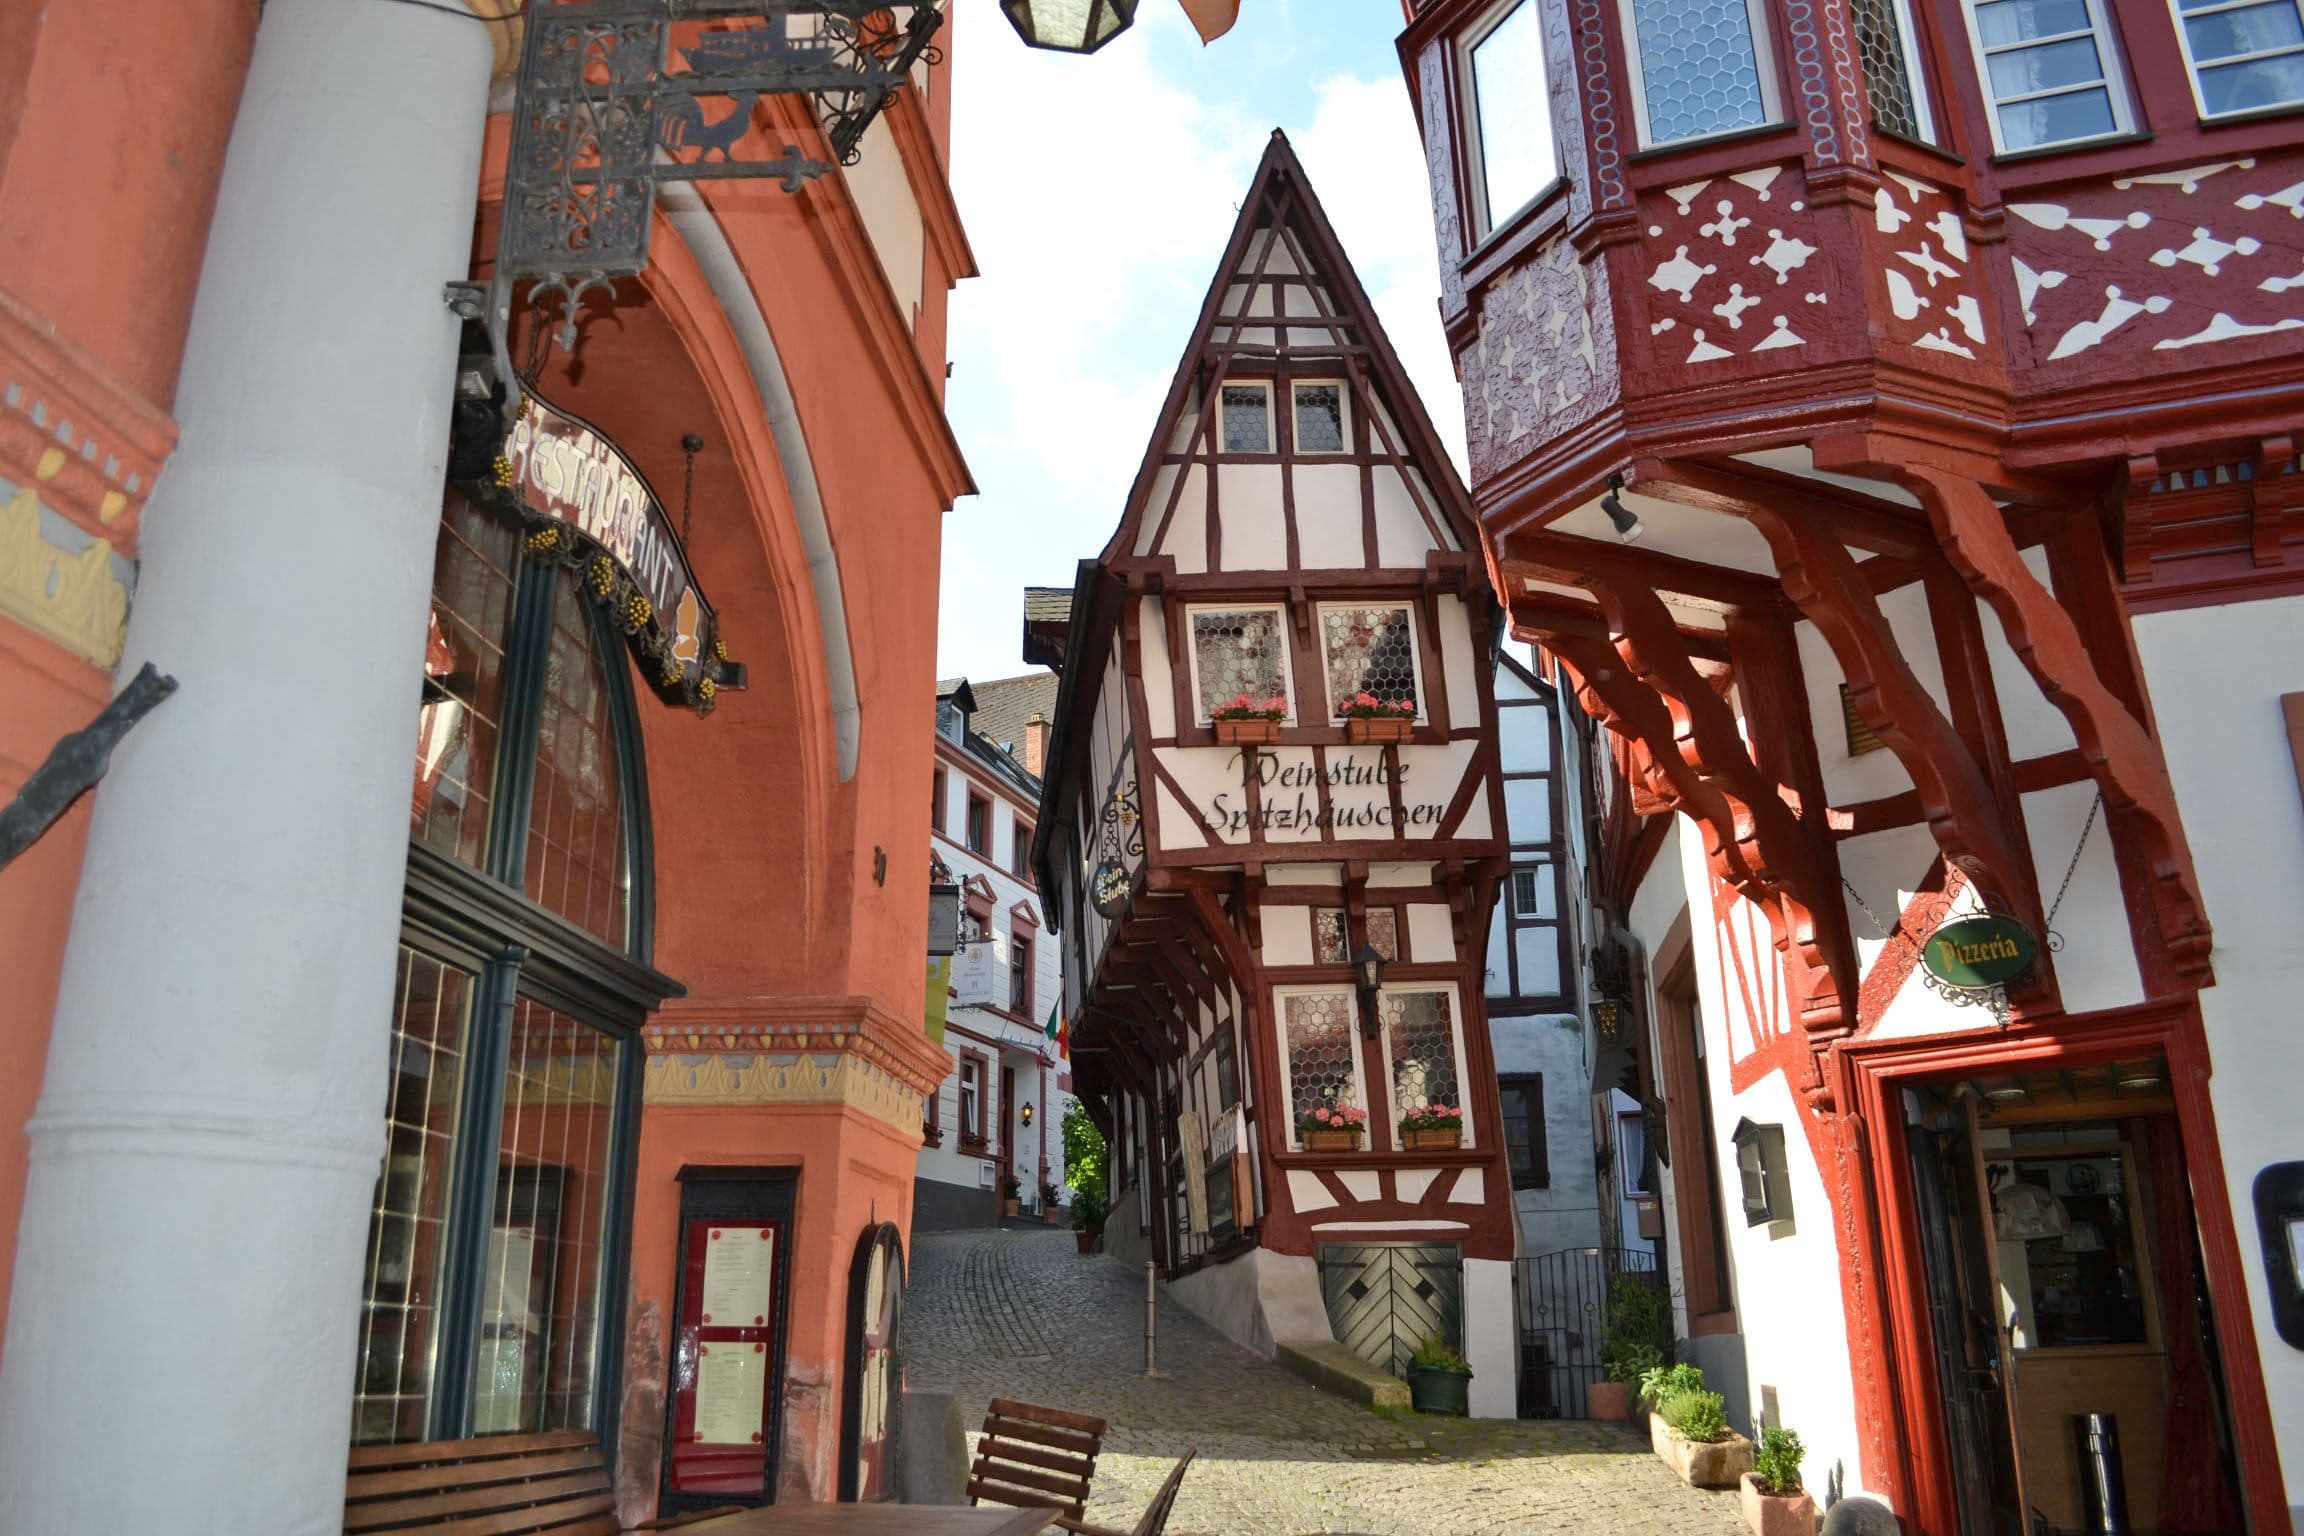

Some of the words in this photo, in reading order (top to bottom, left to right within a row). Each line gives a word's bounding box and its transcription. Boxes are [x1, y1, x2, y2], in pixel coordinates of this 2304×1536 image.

[506, 420, 674, 610] RESTAURANT
[1227, 748, 1411, 789] Weinstube
[1936, 933, 2019, 973] Pizzeria
